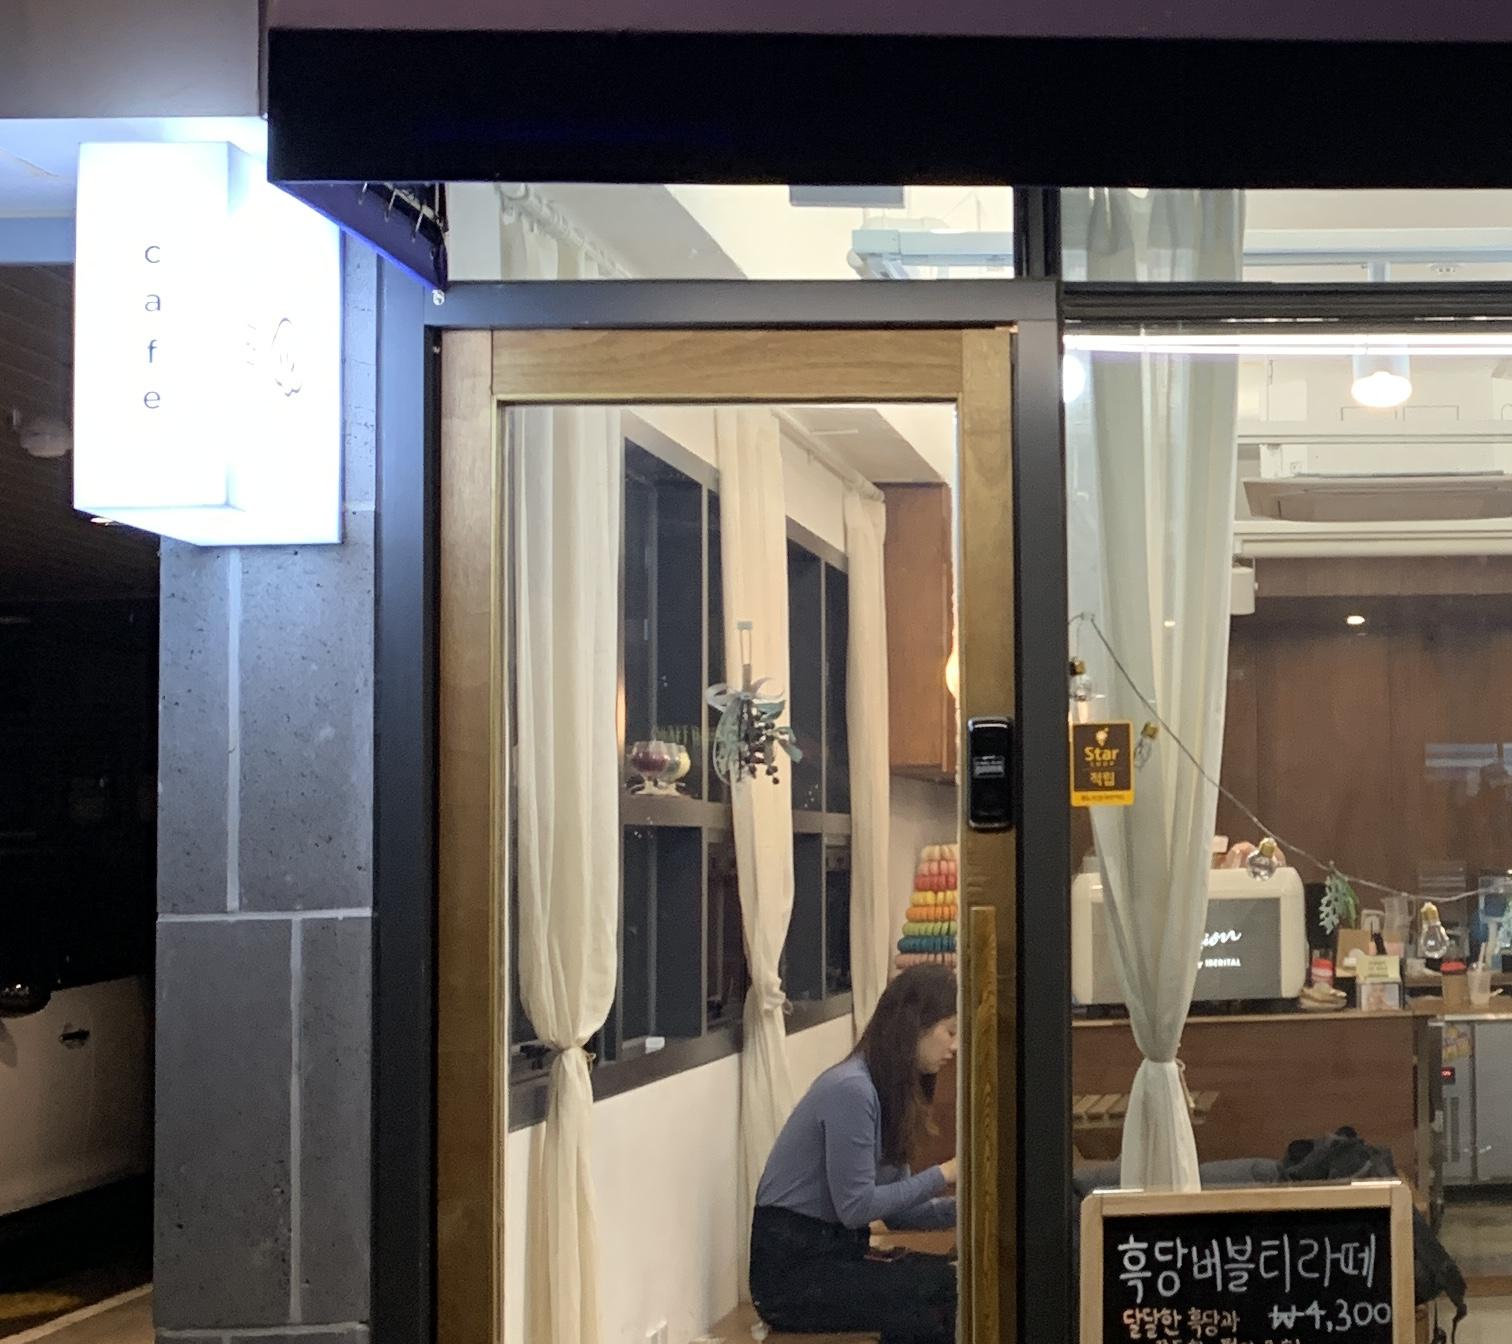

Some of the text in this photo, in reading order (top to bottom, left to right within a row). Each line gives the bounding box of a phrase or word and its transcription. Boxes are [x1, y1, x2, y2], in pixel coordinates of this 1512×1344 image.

[144, 244, 161, 409] cafe
[1084, 746, 1120, 762] Star
[1118, 1233, 1376, 1304] 흑당버블티라떼
[1123, 1306, 1240, 1339] 달달한 흑당과
